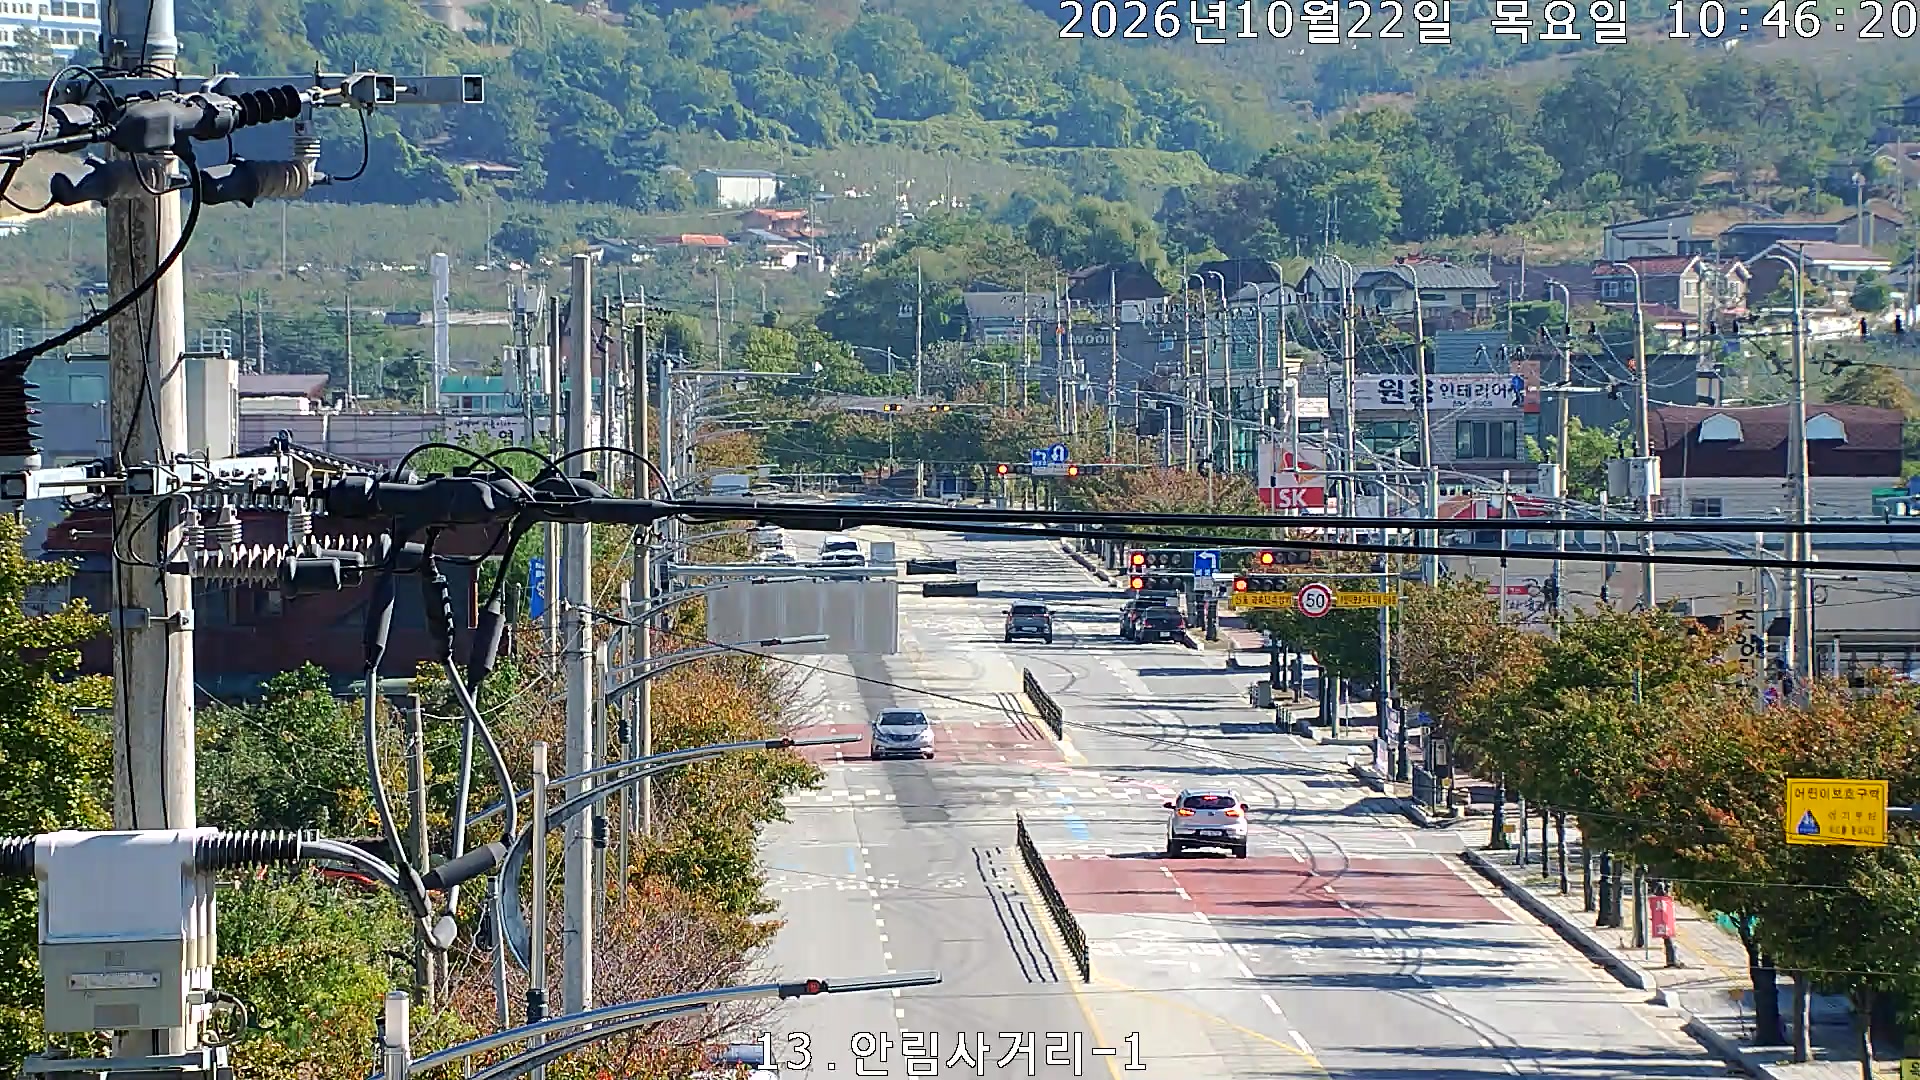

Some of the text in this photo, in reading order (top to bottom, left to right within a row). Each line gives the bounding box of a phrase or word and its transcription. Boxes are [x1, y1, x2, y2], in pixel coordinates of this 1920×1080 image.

[1439, 383, 1506, 399] 인테리어
[1279, 488, 1308, 508] SK
[1305, 593, 1325, 608] 50
[1794, 787, 1881, 801] 어린이보호구역
